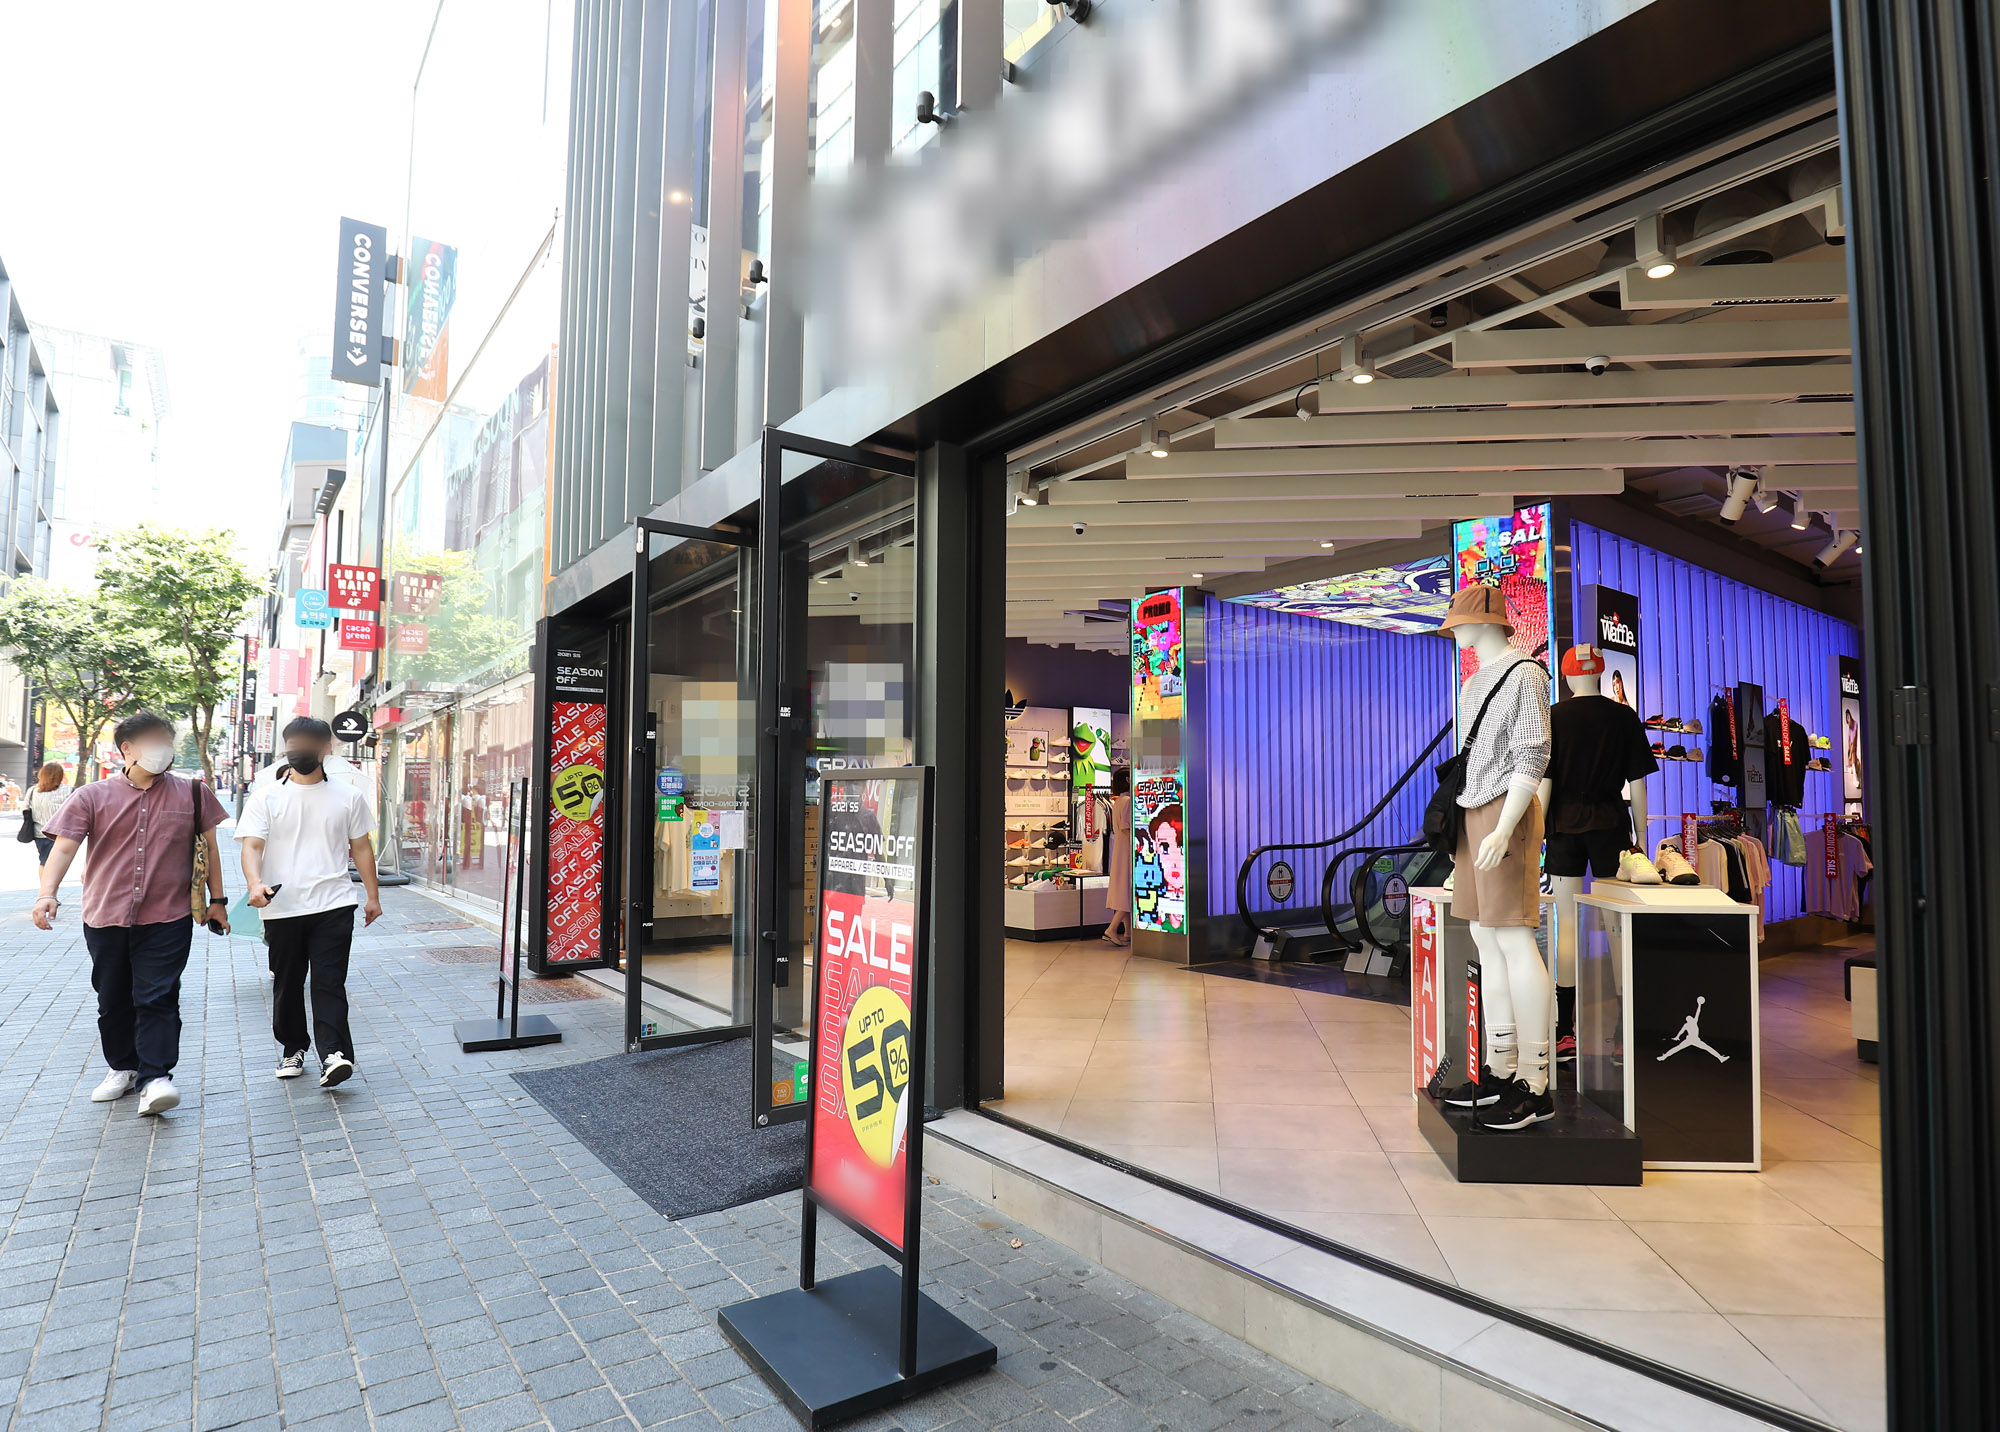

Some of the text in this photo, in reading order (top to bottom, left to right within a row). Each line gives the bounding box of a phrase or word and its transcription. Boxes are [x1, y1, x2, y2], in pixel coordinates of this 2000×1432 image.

[350, 233, 372, 346] CONVERSE
[333, 568, 376, 582] JUNO
[338, 579, 371, 591] HAIR
[346, 597, 361, 606] 4F
[345, 624, 371, 633] cacao
[345, 631, 371, 640] green
[556, 666, 603, 678] SEASON
[556, 675, 578, 685] OFF
[564, 770, 583, 782] UP TO
[1137, 781, 1176, 793] GRAND
[1138, 794, 1172, 804] STAGE
[831, 801, 848, 813] 2021
[552, 825, 595, 863] SALE
[829, 831, 915, 858] SEASON OFF
[550, 857, 578, 886] OFF
[830, 858, 857, 871] APPAREL
[862, 862, 891, 876] SEASON
[891, 865, 914, 879] ITEMS
[1827, 859, 1836, 876] SALE
[826, 909, 911, 975] SALE
[858, 1007, 884, 1034] UP TO
[1467, 985, 1477, 1077] SALE
[847, 1019, 910, 1122] 50%
